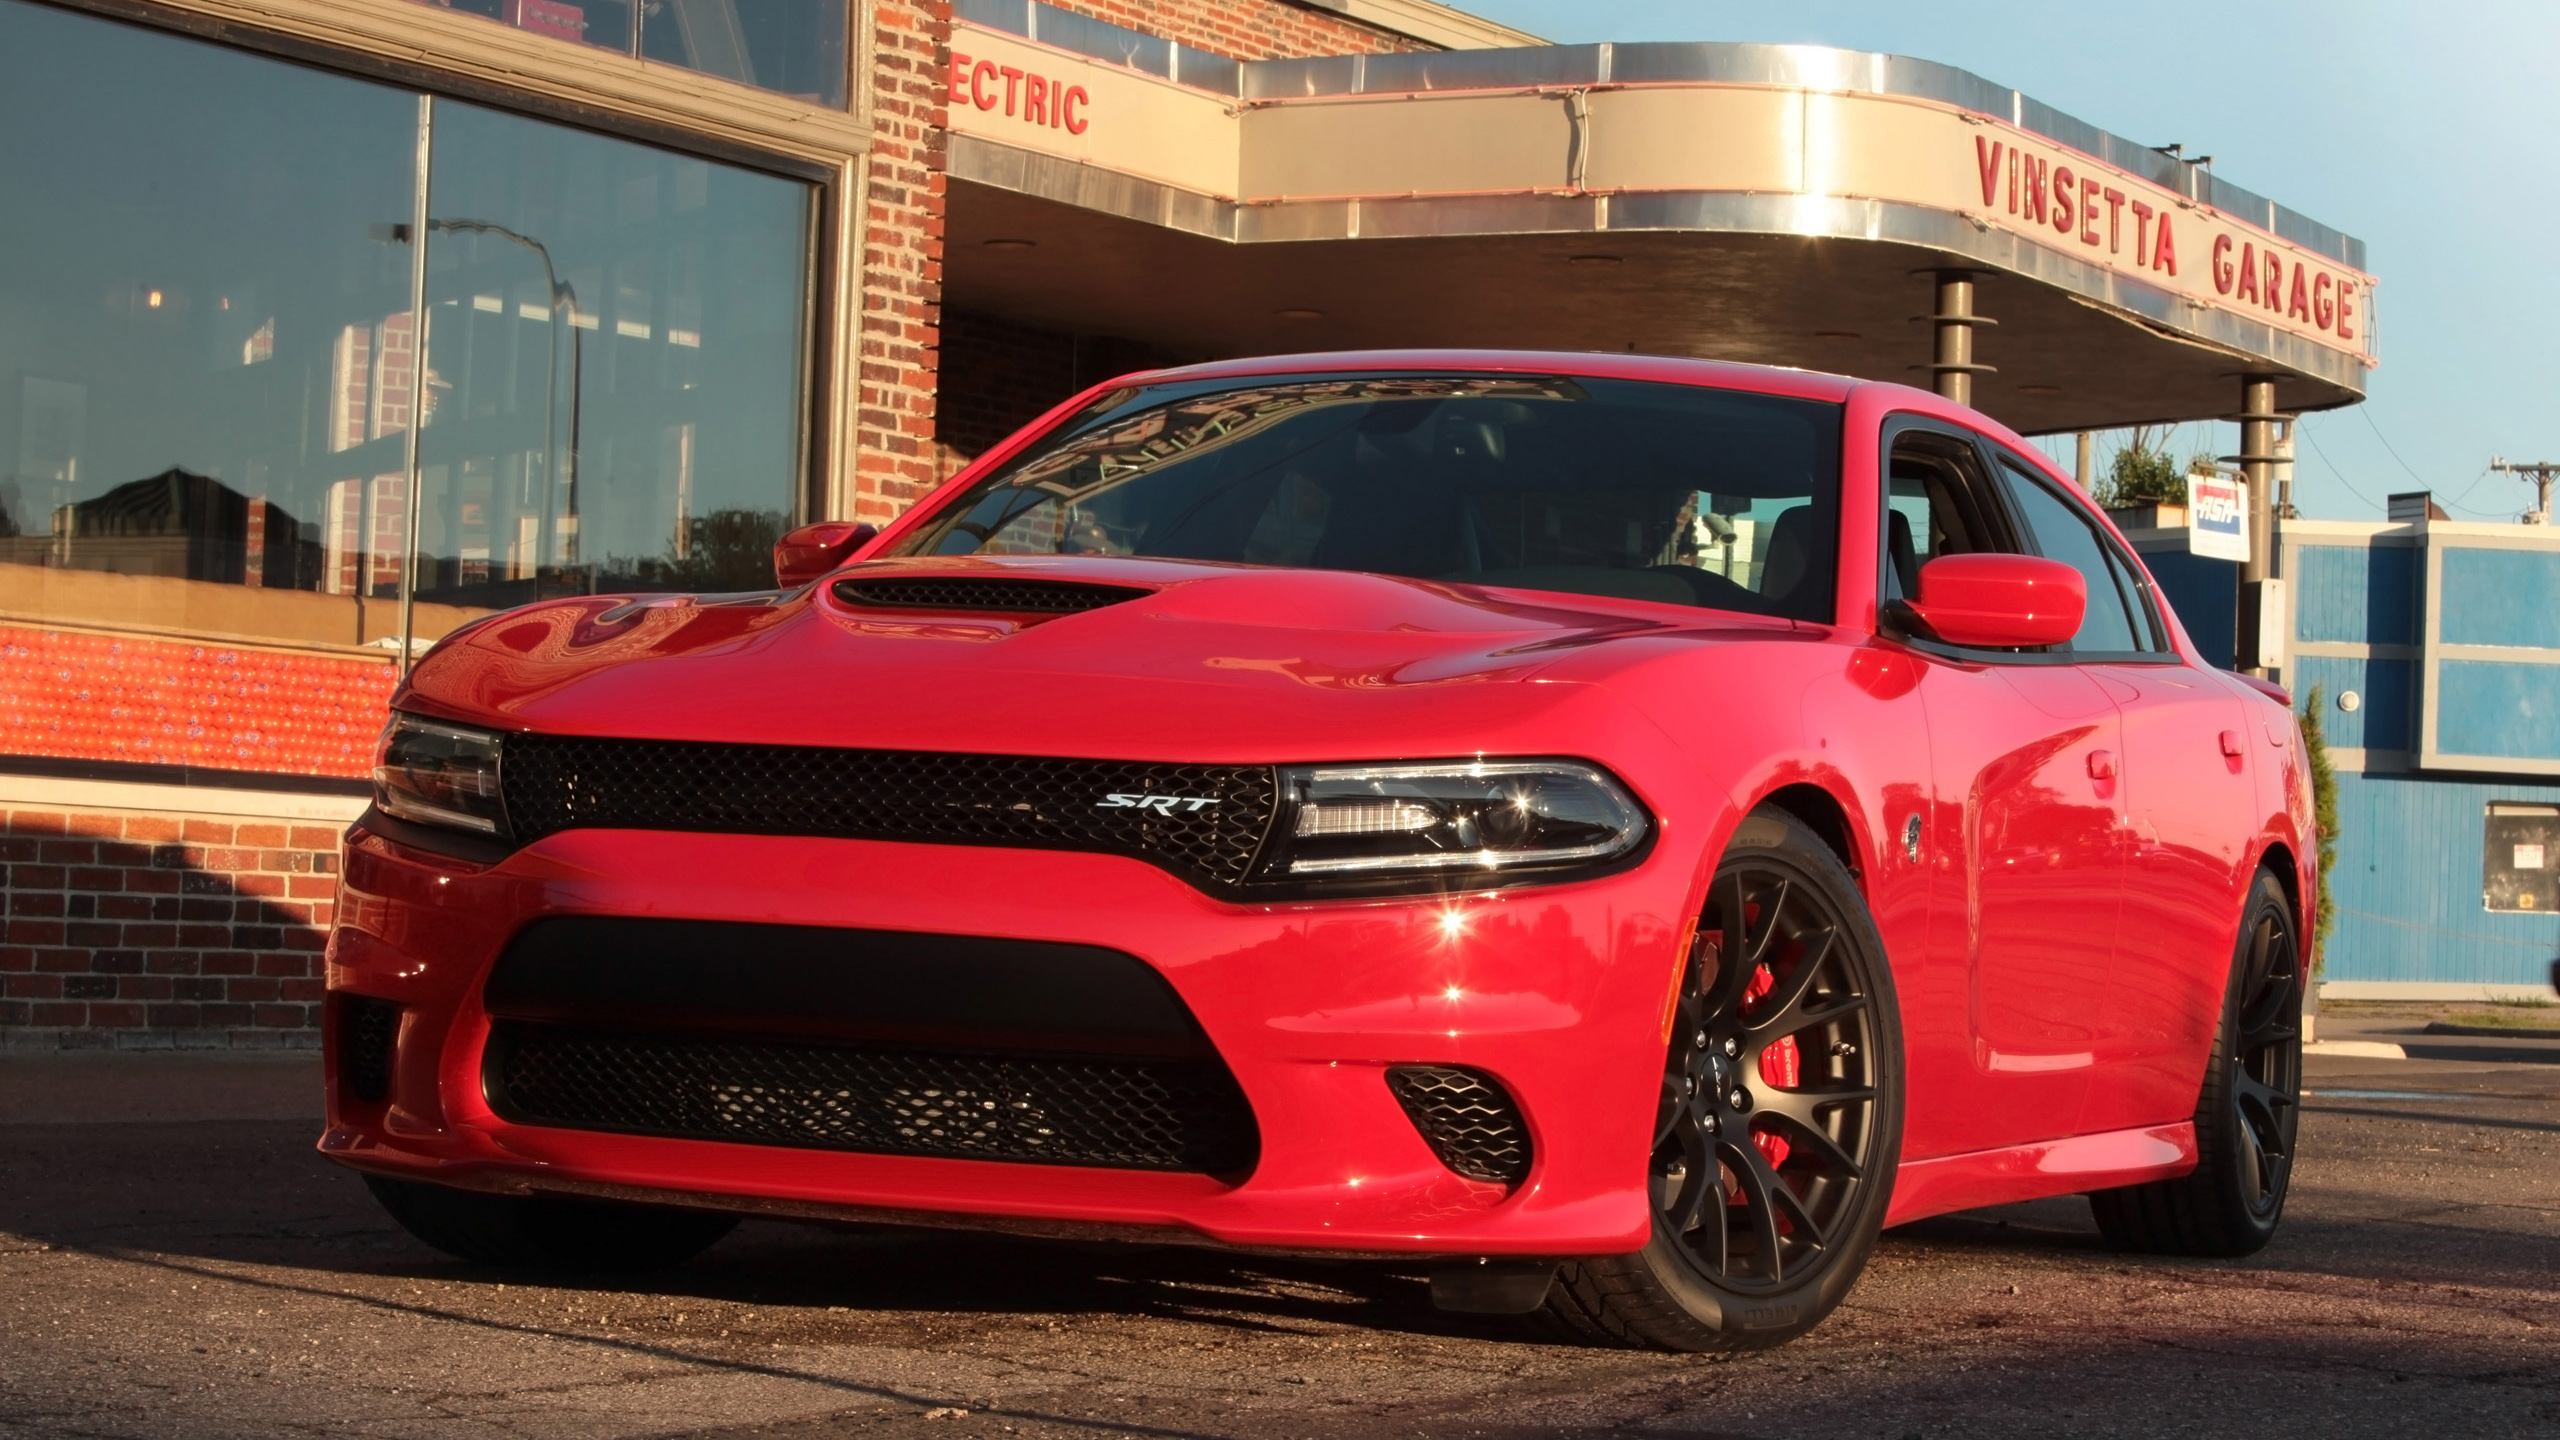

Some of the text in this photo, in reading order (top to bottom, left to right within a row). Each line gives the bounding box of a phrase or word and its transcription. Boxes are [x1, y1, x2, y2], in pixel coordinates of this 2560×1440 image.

[1976, 135, 2353, 339] VINSETTA GARAGE
[2199, 495, 2236, 523] ASA
[1096, 794, 1221, 817] SRT
